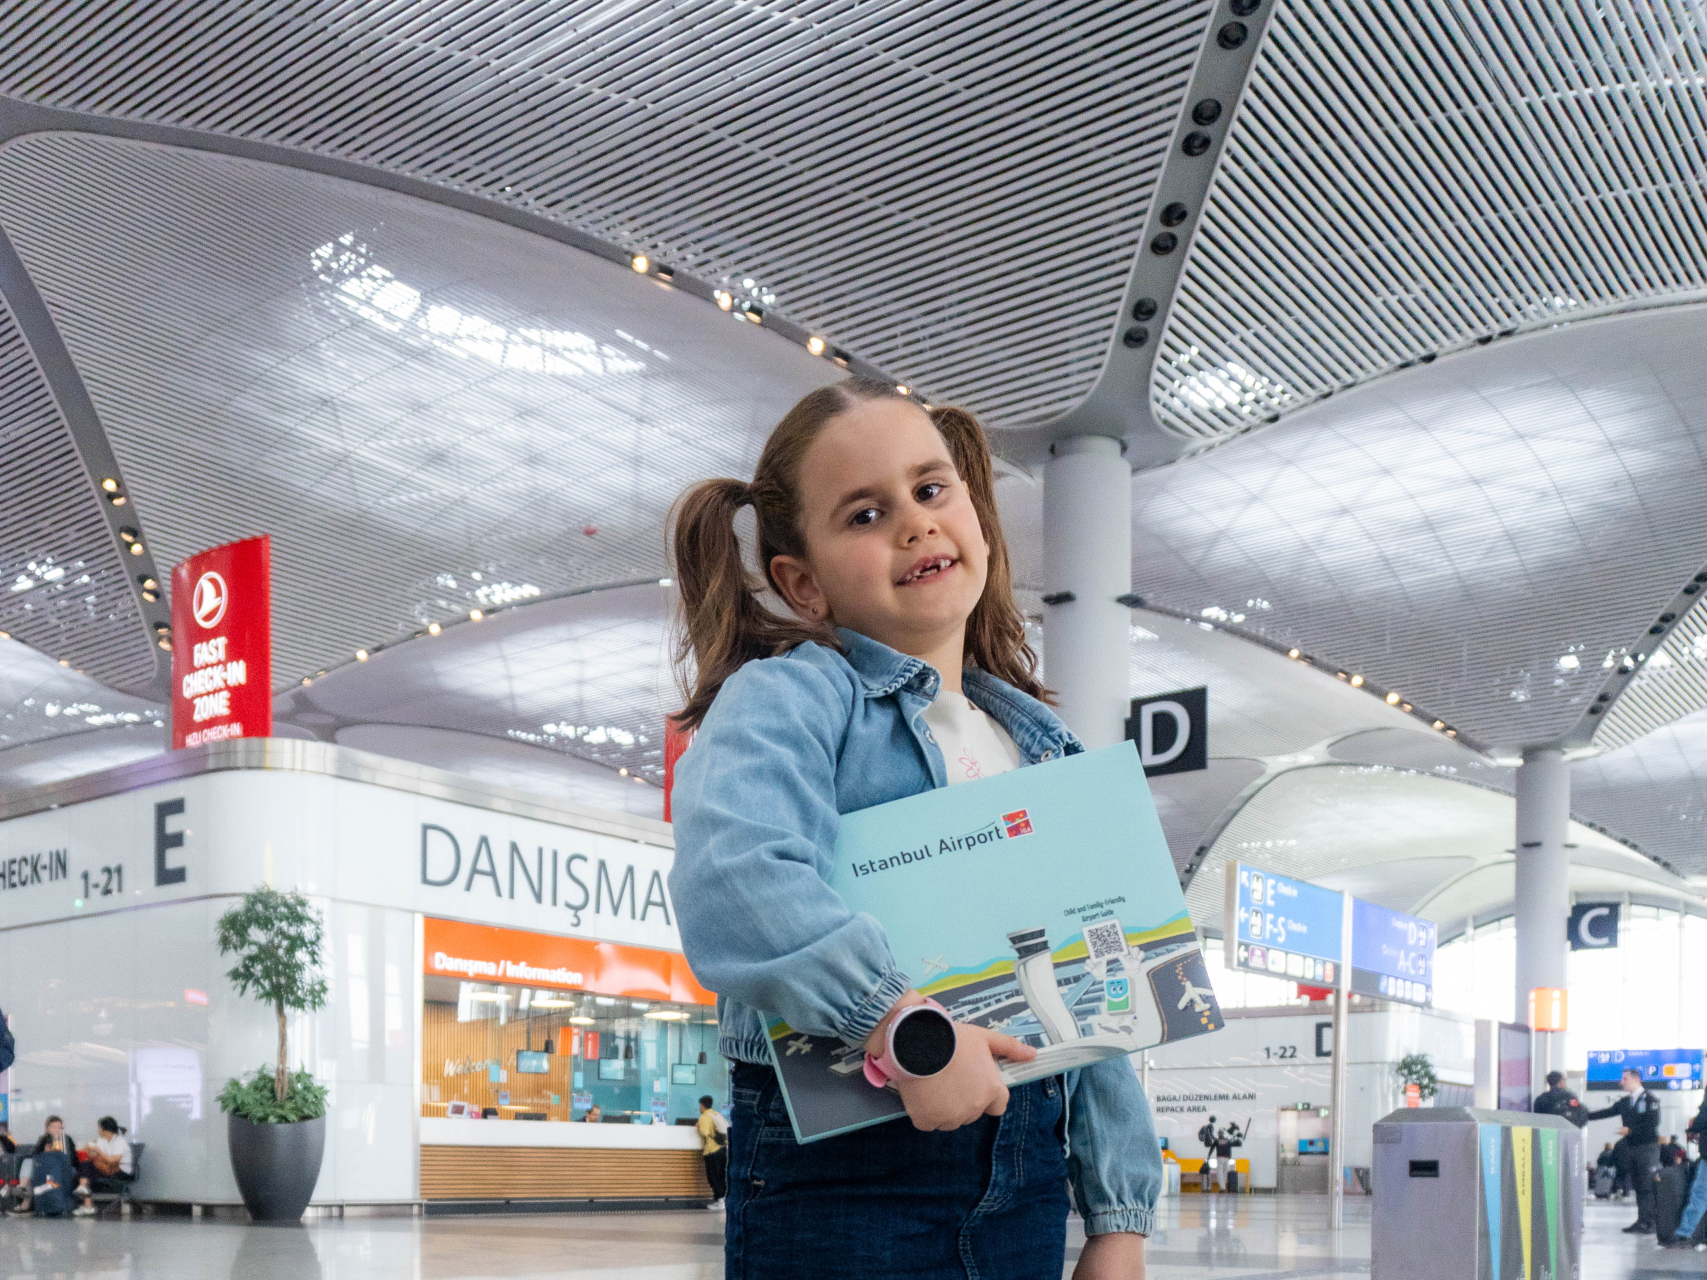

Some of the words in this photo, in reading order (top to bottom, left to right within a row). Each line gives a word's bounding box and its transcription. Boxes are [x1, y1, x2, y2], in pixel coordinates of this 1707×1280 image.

[193, 636, 228, 667] FAST
[182, 660, 246, 699] CHECK-IN
[192, 690, 230, 722] ZONE
[185, 729, 203, 748] HIZLI
[202, 722, 242, 743] CHECK-IN
[1141, 700, 1191, 766] D
[155, 797, 186, 886] E
[851, 844, 932, 878] Istanbul
[939, 826, 1003, 854] Airport
[81, 864, 123, 898] 1-21
[420, 823, 671, 928] DANIŞMA
[1266, 878, 1276, 906] E
[1063, 907, 1076, 916] Child
[1077, 905, 1087, 913] and
[1081, 912, 1099, 922] Airport
[1100, 909, 1114, 918] Guide
[1580, 907, 1610, 945] C
[1266, 913, 1286, 944] F-S
[1408, 922, 1417, 945] D
[434, 951, 496, 976] Danışma
[506, 961, 583, 984] Information
[1398, 949, 1416, 975] A-C
[1264, 1045, 1297, 1059] 1-22
[1614, 1051, 1625, 1063] D
[1156, 1094, 1181, 1102] BAGAJ
[1183, 1093, 1230, 1102] DÜZENLEME
[1232, 1093, 1256, 1101] ALANI
[1187, 1105, 1207, 1113] AREA
